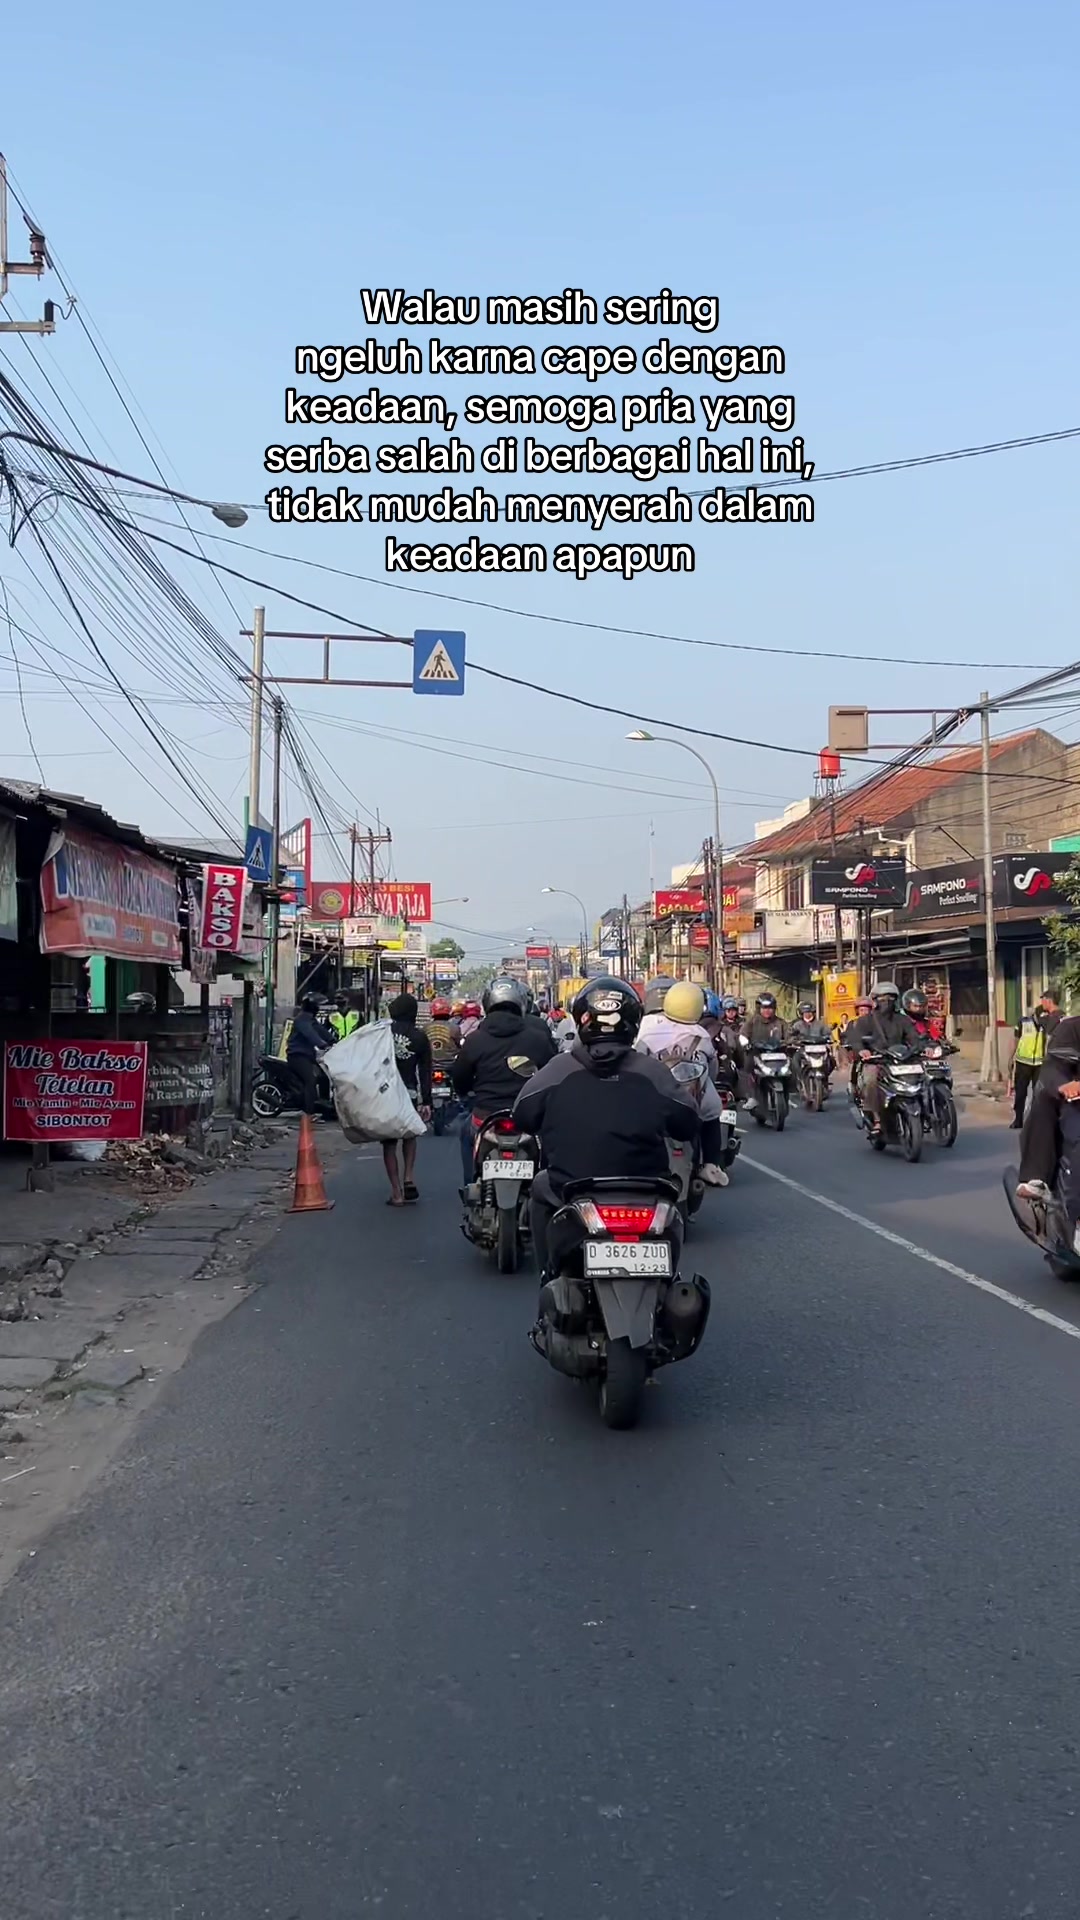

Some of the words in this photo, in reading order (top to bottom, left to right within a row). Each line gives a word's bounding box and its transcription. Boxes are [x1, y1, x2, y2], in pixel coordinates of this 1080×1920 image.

[920, 878, 966, 895] SAMPONO
[207, 872, 237, 946] BAKSO
[8, 1045, 54, 1069] Mie
[60, 1047, 142, 1072] Bakso
[35, 1073, 114, 1095] Tetelan
[103, 1098, 136, 1110] Ayam
[35, 1113, 111, 1127] SIBONTOT
[484, 1162, 489, 1170] D
[589, 1245, 597, 1258] D
[605, 1245, 636, 1258] 3626
[642, 1245, 667, 1258] ZUD
